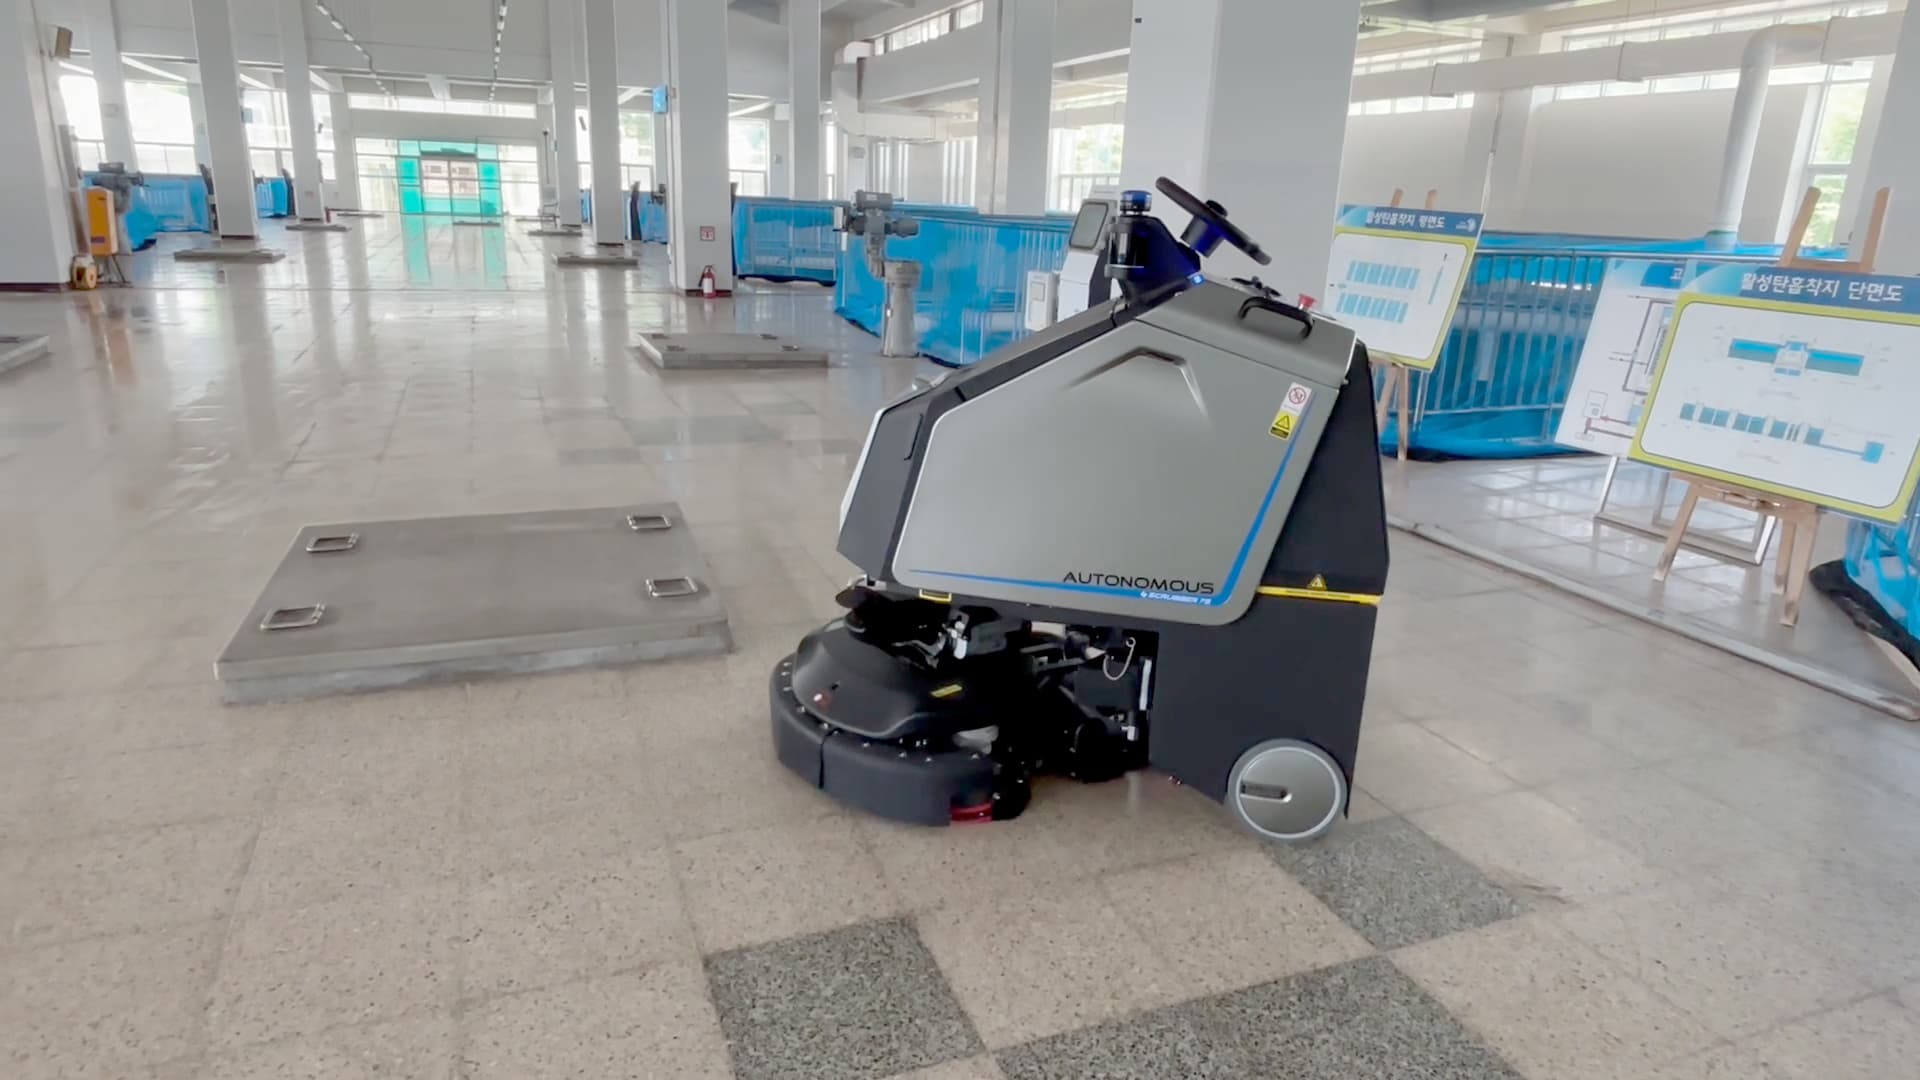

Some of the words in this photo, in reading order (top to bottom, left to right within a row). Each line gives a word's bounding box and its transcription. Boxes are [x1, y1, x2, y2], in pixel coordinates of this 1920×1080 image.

[1742, 272, 1840, 298] 활성탄흡착지
[1848, 281, 1903, 302] 단면도
[1063, 571, 1215, 594] AUTONOMOUS
